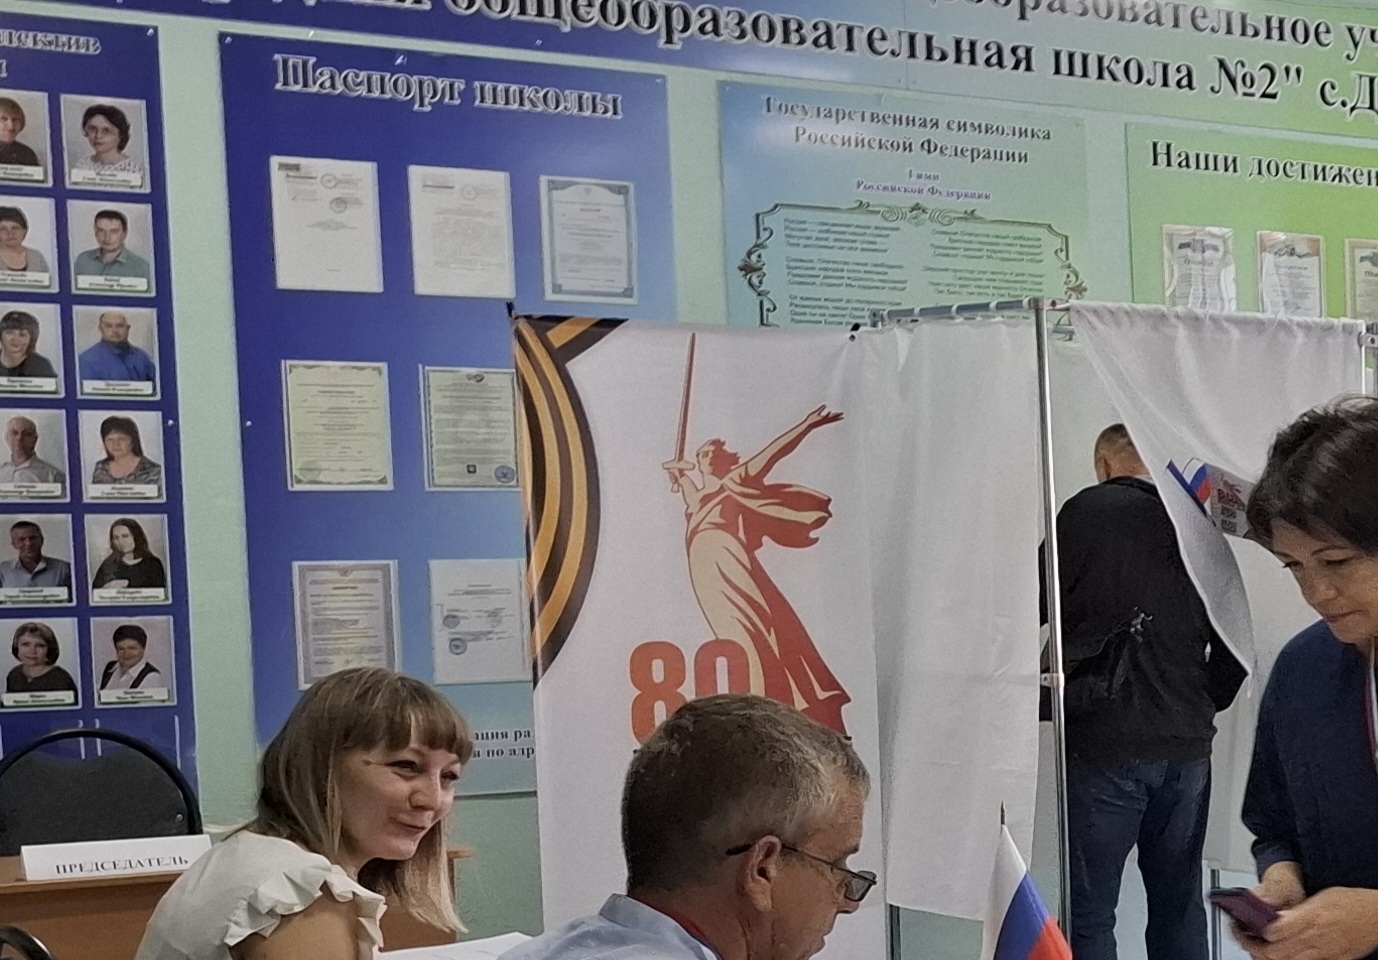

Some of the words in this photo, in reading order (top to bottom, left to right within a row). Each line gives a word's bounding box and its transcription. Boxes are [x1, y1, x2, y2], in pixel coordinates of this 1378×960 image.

[272, 53, 466, 112] Паспорт
[474, 80, 623, 119] школы
[1050, 47, 1198, 92] школа
[763, 96, 940, 131] Государственная
[945, 116, 1053, 141] символика
[794, 125, 915, 154] Российской
[919, 137, 1030, 165] Федерации
[1149, 139, 1240, 174] Наши
[629, 638, 751, 747] 80
[55, 855, 188, 875] ПРЕДСЕДАТЕЛЬ
